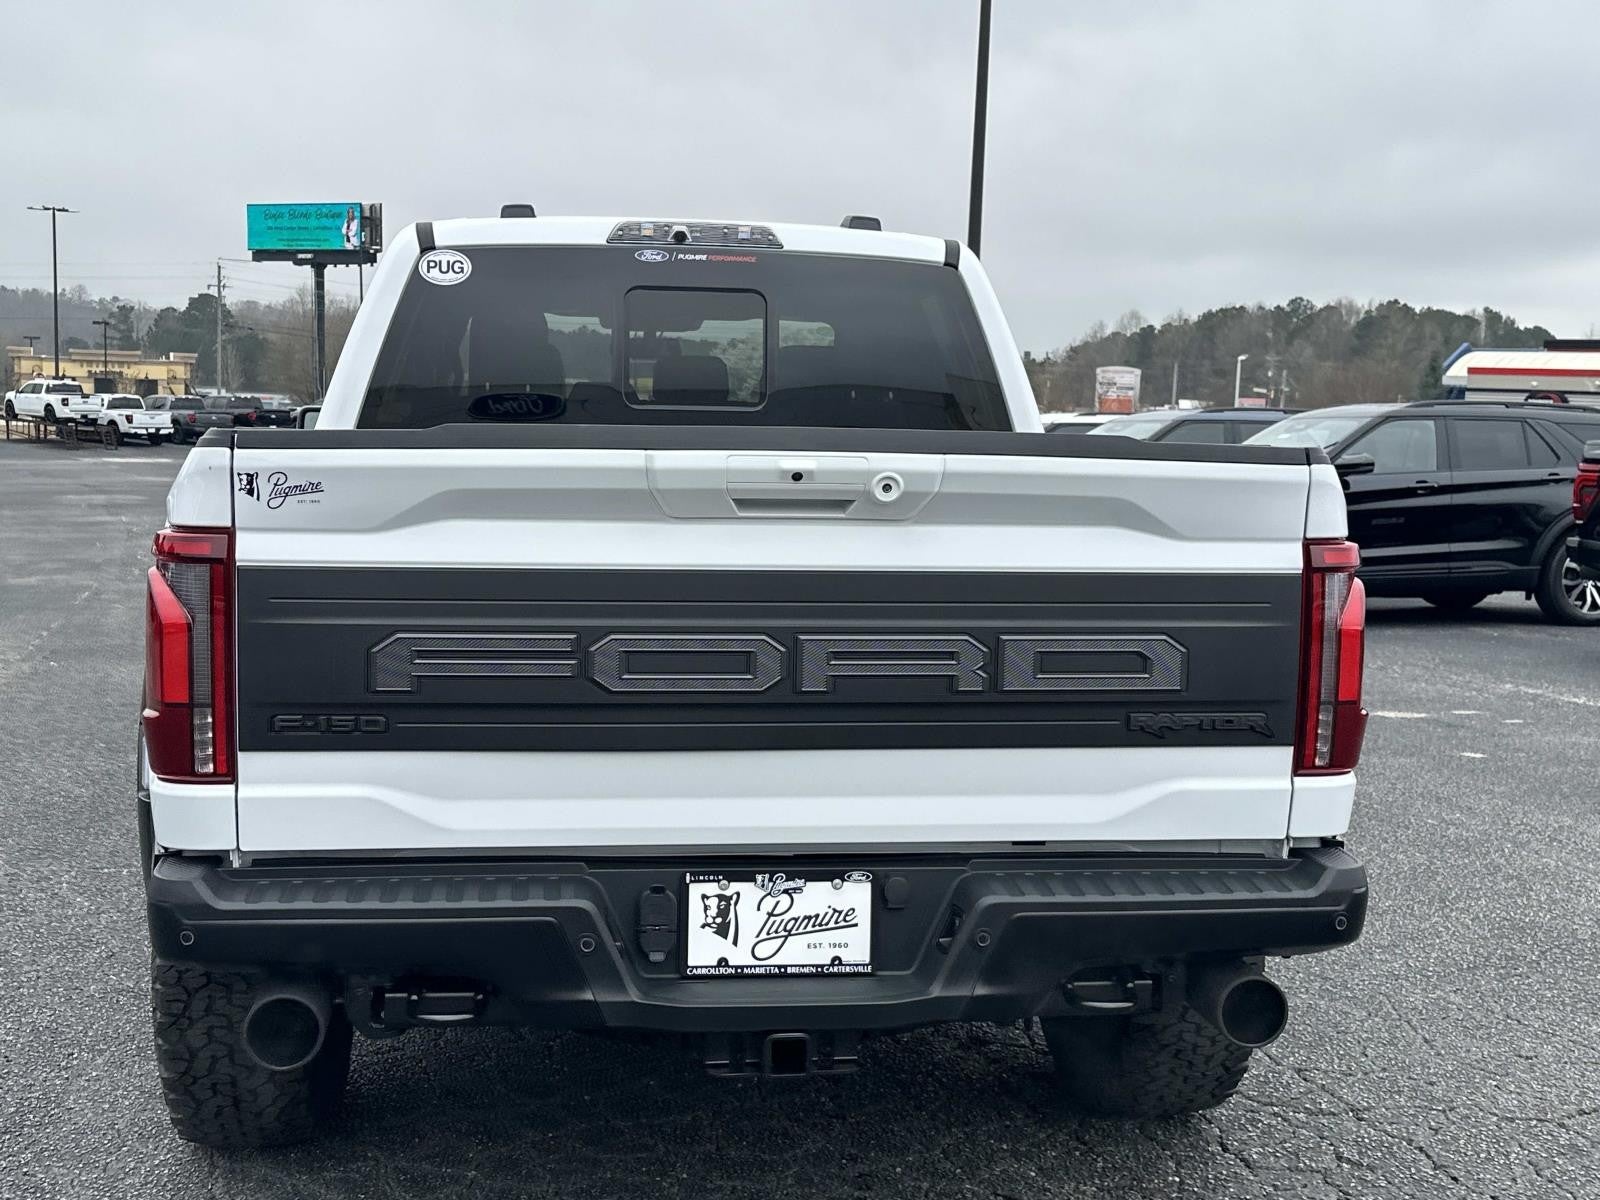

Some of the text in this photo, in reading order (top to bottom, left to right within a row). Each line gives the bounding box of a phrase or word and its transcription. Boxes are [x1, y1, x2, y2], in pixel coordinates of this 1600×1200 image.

[426, 260, 465, 275] PUG
[678, 253, 707, 261] PUGMIRE
[708, 254, 757, 263] PERFORMANCE
[267, 471, 325, 510] Pugmire
[368, 631, 1189, 694] FORD
[271, 714, 388, 733] F-150
[1127, 712, 1275, 739] RAPTOR
[750, 891, 859, 962] Pugmire
[686, 965, 873, 976] CARROLLTON MARIETTA BREMEN CARTERSVILLE
